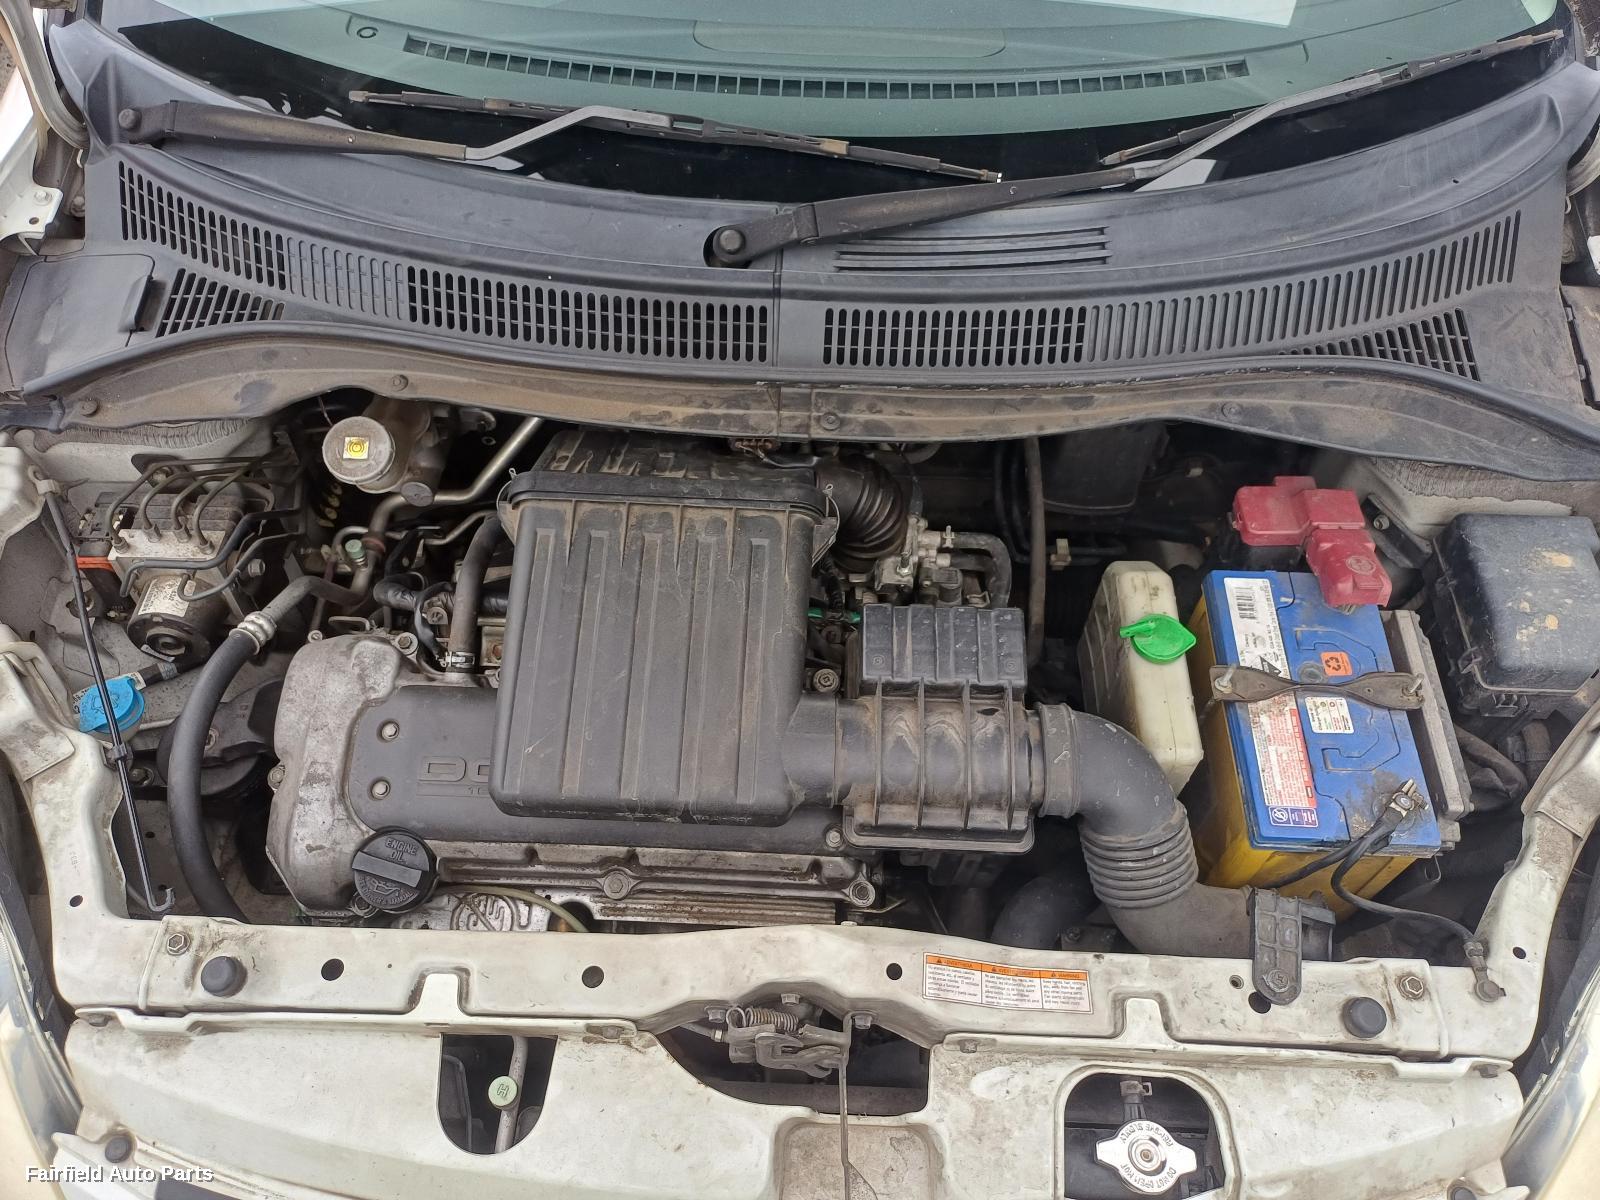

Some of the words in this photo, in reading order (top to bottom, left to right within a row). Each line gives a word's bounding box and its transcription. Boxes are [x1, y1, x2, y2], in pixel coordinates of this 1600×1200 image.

[385, 838, 417, 856] ENGINE
[390, 850, 404, 862] OIL
[389, 891, 414, 905] MANUAL
[1167, 1166, 1177, 1179] DO
[1157, 1177, 1171, 1189] NOT
